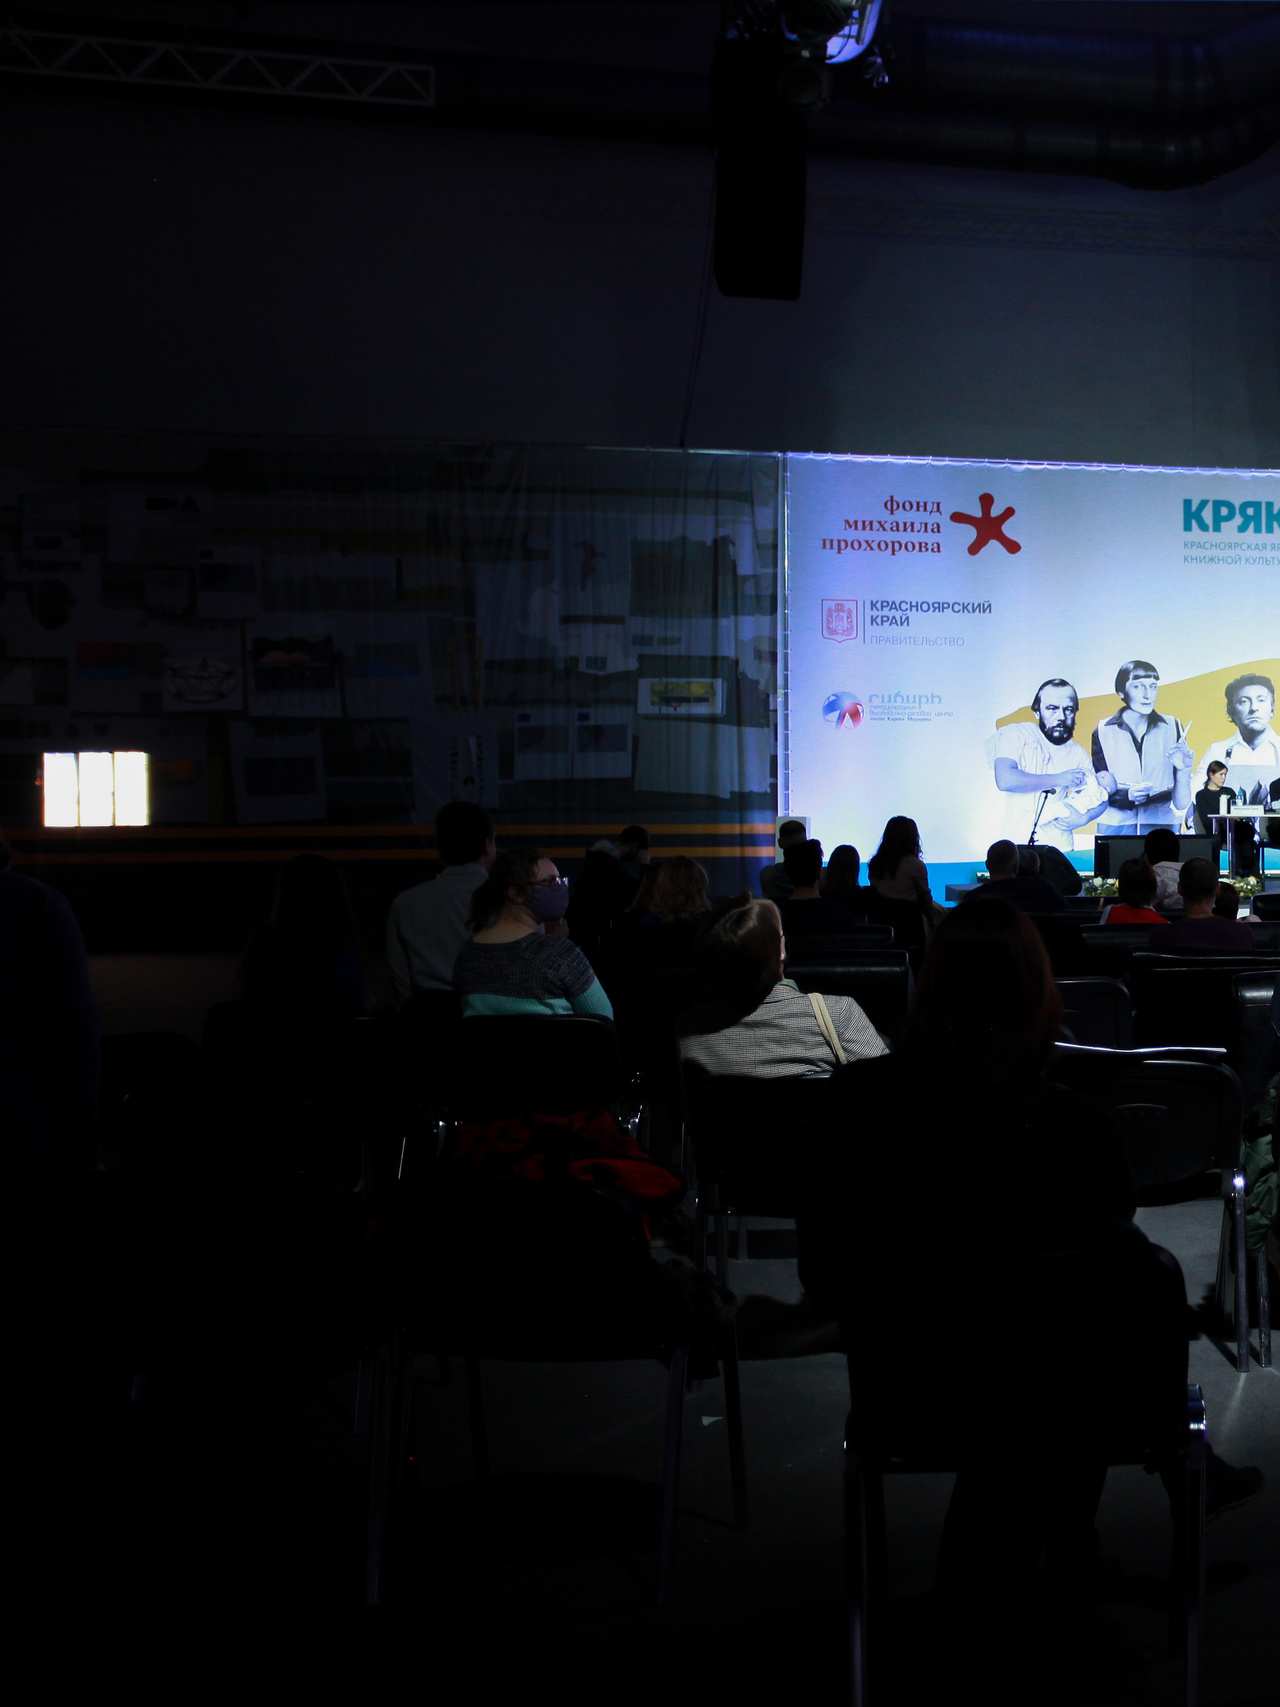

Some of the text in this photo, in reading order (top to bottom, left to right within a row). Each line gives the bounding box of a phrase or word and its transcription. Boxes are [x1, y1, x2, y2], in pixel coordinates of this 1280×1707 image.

[884, 495, 942, 516] фонд
[843, 519, 942, 534] михаила
[821, 538, 942, 556] прохорова
[1183, 540, 1267, 552] КРАСНОЯРСКАЯ
[1183, 554, 1242, 565] КНИЖНОЙ
[870, 600, 992, 614] КРАСНОЯРСКИЙ
[870, 614, 910, 627] КРАЙ
[870, 635, 965, 647] ПРАВИТЕЛЬСТВО
